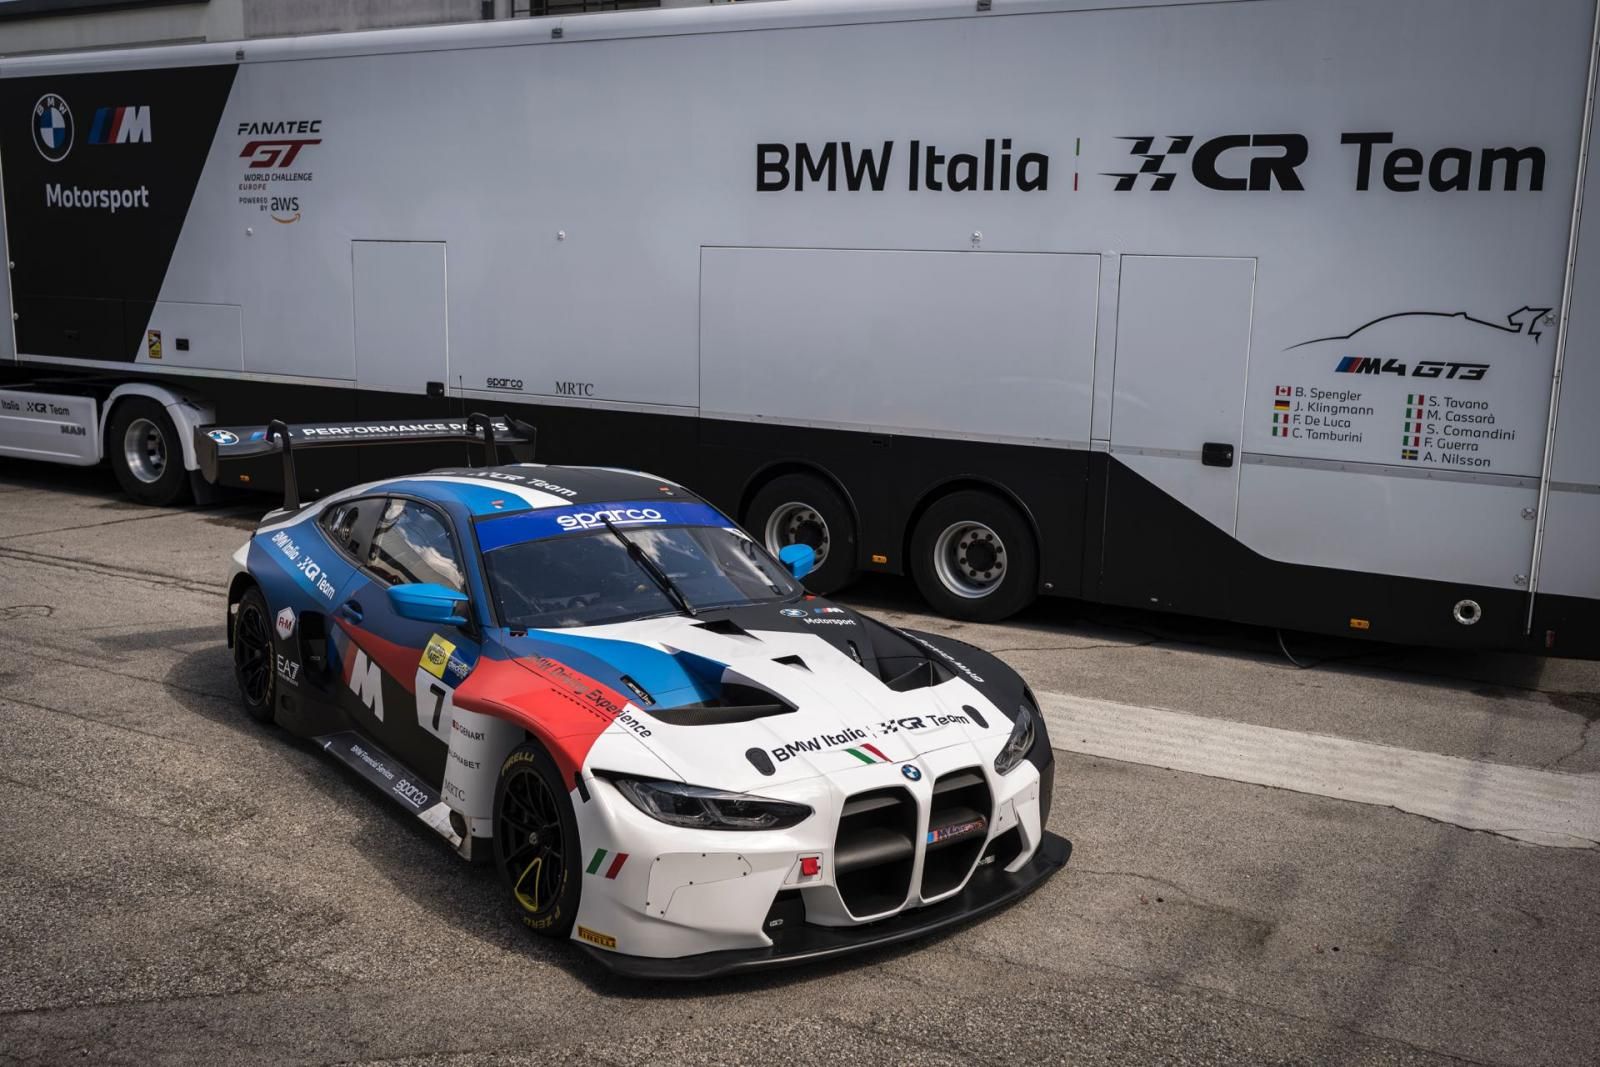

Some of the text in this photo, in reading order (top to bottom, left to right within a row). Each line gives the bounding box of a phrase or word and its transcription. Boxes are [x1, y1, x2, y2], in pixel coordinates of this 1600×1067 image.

[237, 120, 322, 135] FANATEC
[239, 139, 322, 168] GT
[756, 131, 1546, 192] BMW Italia CR Team
[244, 172, 312, 181] WORLD CHALLENGE
[45, 184, 150, 214] Motorsport
[239, 196, 268, 204] POWERED
[271, 196, 300, 211] aws
[1354, 357, 1491, 381] M4 GT3
[486, 377, 524, 391] sparco
[555, 381, 594, 396] MRTC
[1295, 386, 1362, 403] B. Spengler
[1429, 396, 1489, 410] S. Tavano
[1, 399, 20, 411] Italia
[49, 404, 70, 416] Team
[1294, 401, 1374, 419] J. Klingmann
[1427, 410, 1441, 421] M.
[302, 422, 450, 437] PERFORMANCE
[1293, 414, 1351, 428] F. De Luca
[60, 425, 87, 436] MAN
[1292, 428, 1362, 443] C. Tamburini
[1427, 424, 1516, 441] S. Comandini
[1424, 437, 1478, 451] F. Guerra
[1424, 451, 1491, 467] A. Nilsson
[528, 478, 578, 497] Team
[556, 508, 667, 531] sparco
[316, 572, 336, 601] Team
[803, 618, 857, 626] Motorsport
[277, 654, 300, 680] EA7
[349, 647, 384, 723] M
[429, 683, 447, 732] 7
[585, 689, 652, 739] Experience
[771, 714, 971, 763] BMW Italia CR Team
